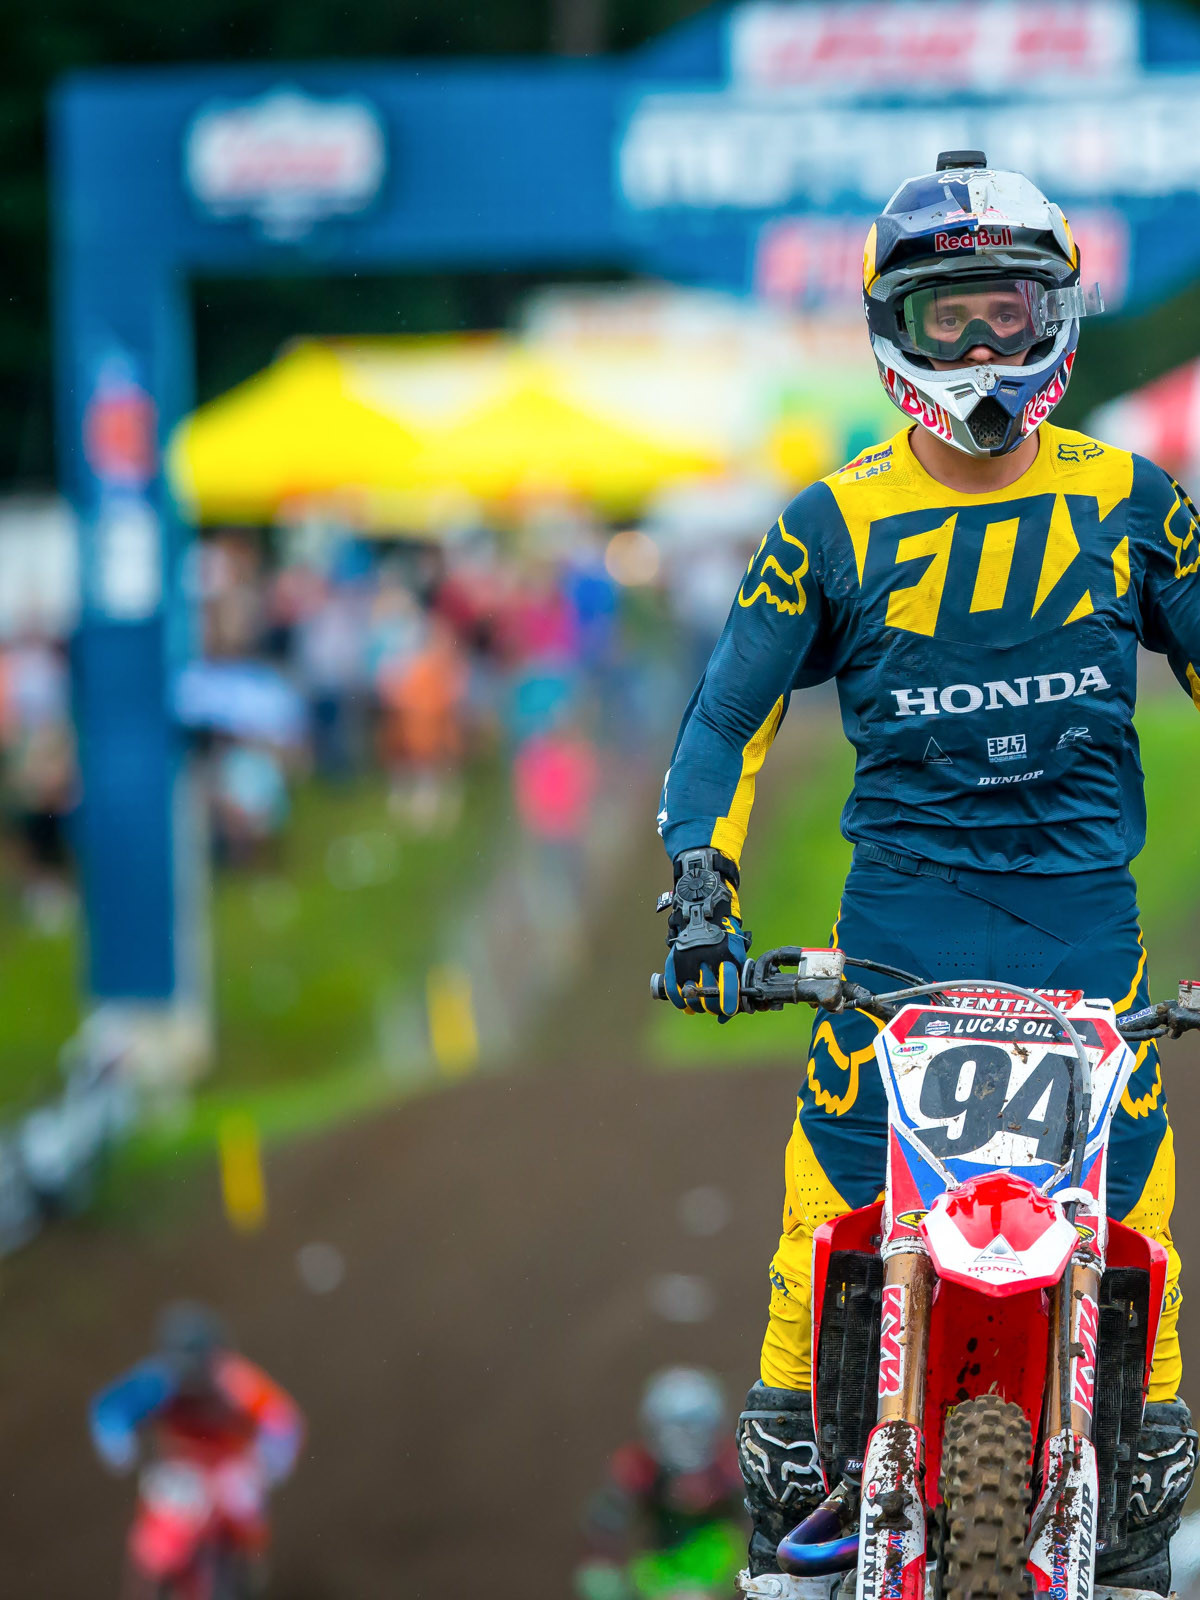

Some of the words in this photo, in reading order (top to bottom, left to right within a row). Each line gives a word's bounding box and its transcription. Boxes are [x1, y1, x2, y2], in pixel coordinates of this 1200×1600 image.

[935, 232, 975, 252] Red
[977, 228, 1013, 247] Bull
[901, 378, 952, 441] Bull
[1022, 374, 1065, 436] Red
[858, 492, 1130, 640] FOX
[891, 665, 1111, 716] HONDA
[977, 769, 1044, 786] DUNLOP
[953, 1018, 1019, 1034] LUCAS
[1023, 1021, 1055, 1038] OIL
[914, 1044, 1091, 1165] 94
[967, 1265, 1028, 1276] HONDA
